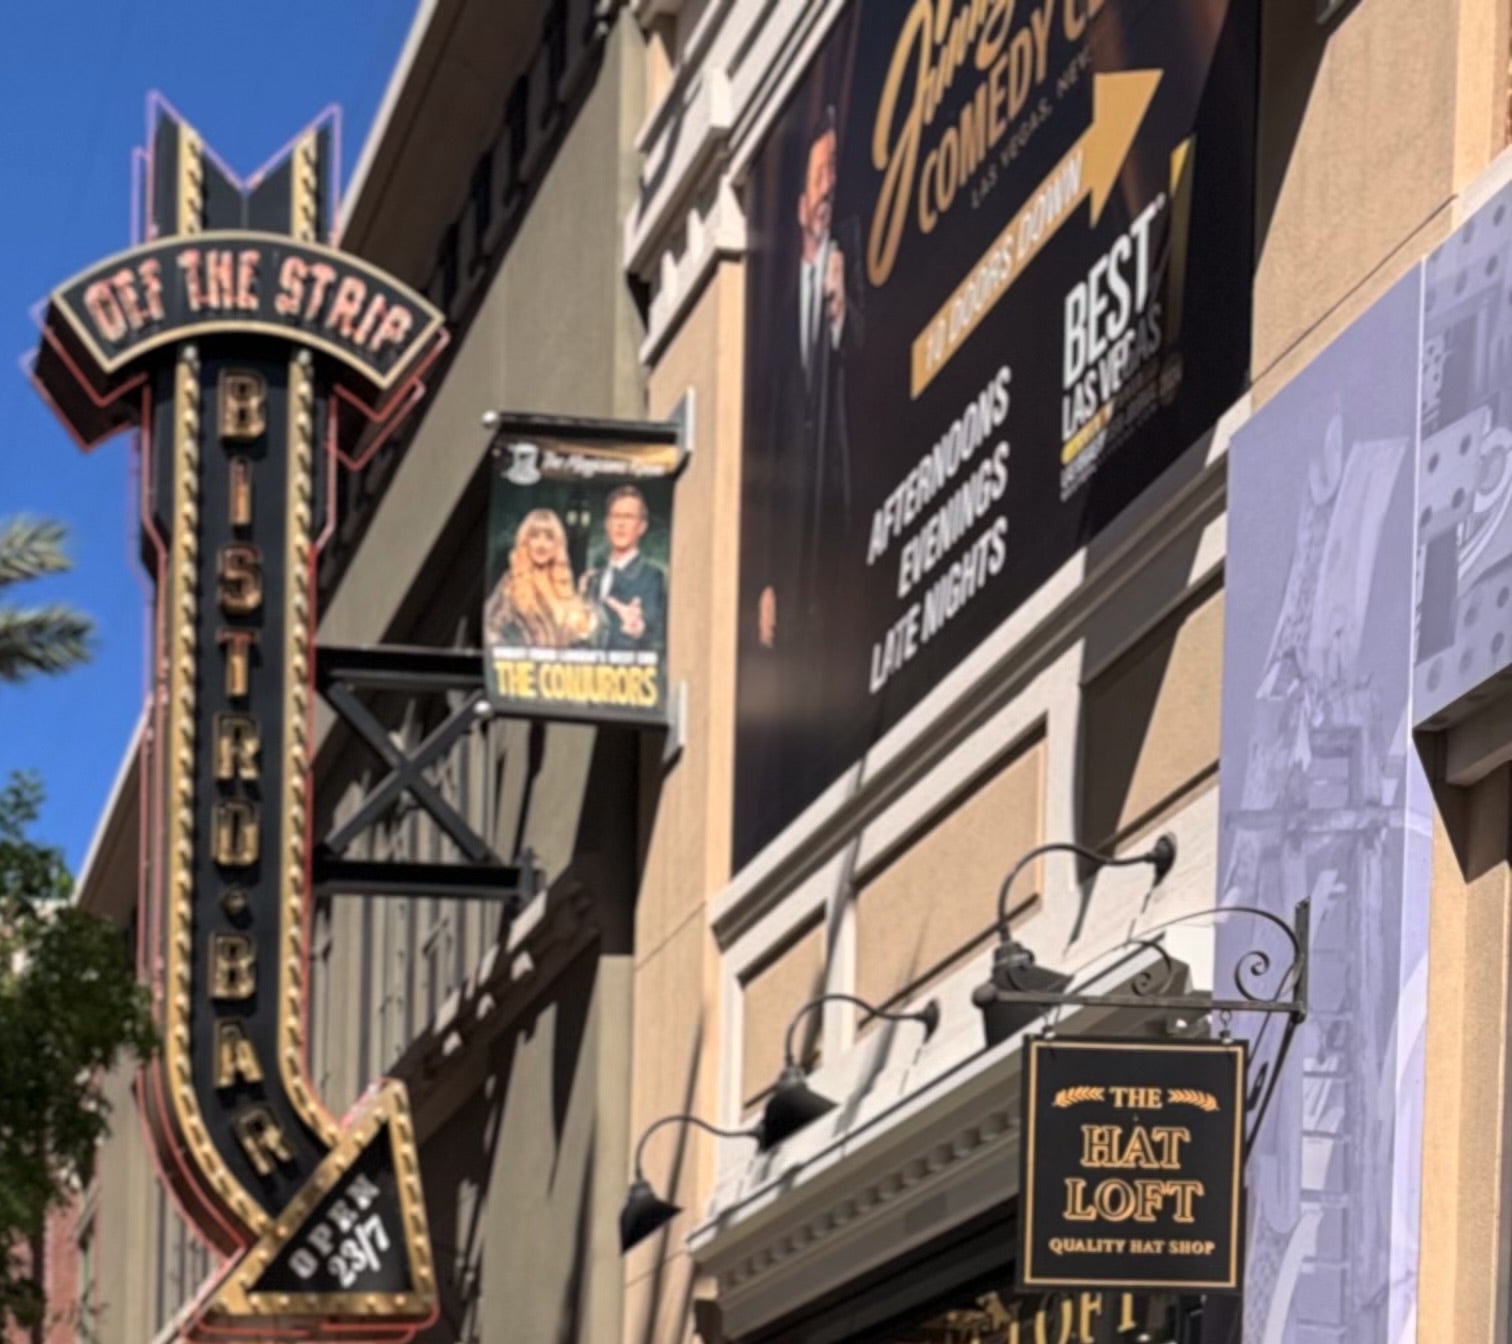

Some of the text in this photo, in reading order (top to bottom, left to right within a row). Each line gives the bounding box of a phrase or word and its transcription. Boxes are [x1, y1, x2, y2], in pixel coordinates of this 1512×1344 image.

[918, 0, 1055, 233] COMEDY
[83, 249, 414, 354] OFF THE STRIP
[925, 147, 1084, 371] 10 DOORS DOWN
[1062, 201, 1158, 389] BEST
[1062, 368, 1098, 442] LAS
[1098, 303, 1162, 402] VEGAS
[866, 365, 1012, 566] AFTERNOONS
[898, 441, 1010, 599] EVENINGS
[869, 515, 1008, 694] LATE NIGHTS
[493, 659, 537, 698] THE
[207, 929, 295, 1177] BAR
[1108, 1086, 1163, 1110] THE
[1063, 1177, 1205, 1223] LOFT
[1080, 1124, 1191, 1170] HAT
[289, 1172, 381, 1279] OPEN
[1048, 1237, 1216, 1256] QUALITY HAT SHOP
